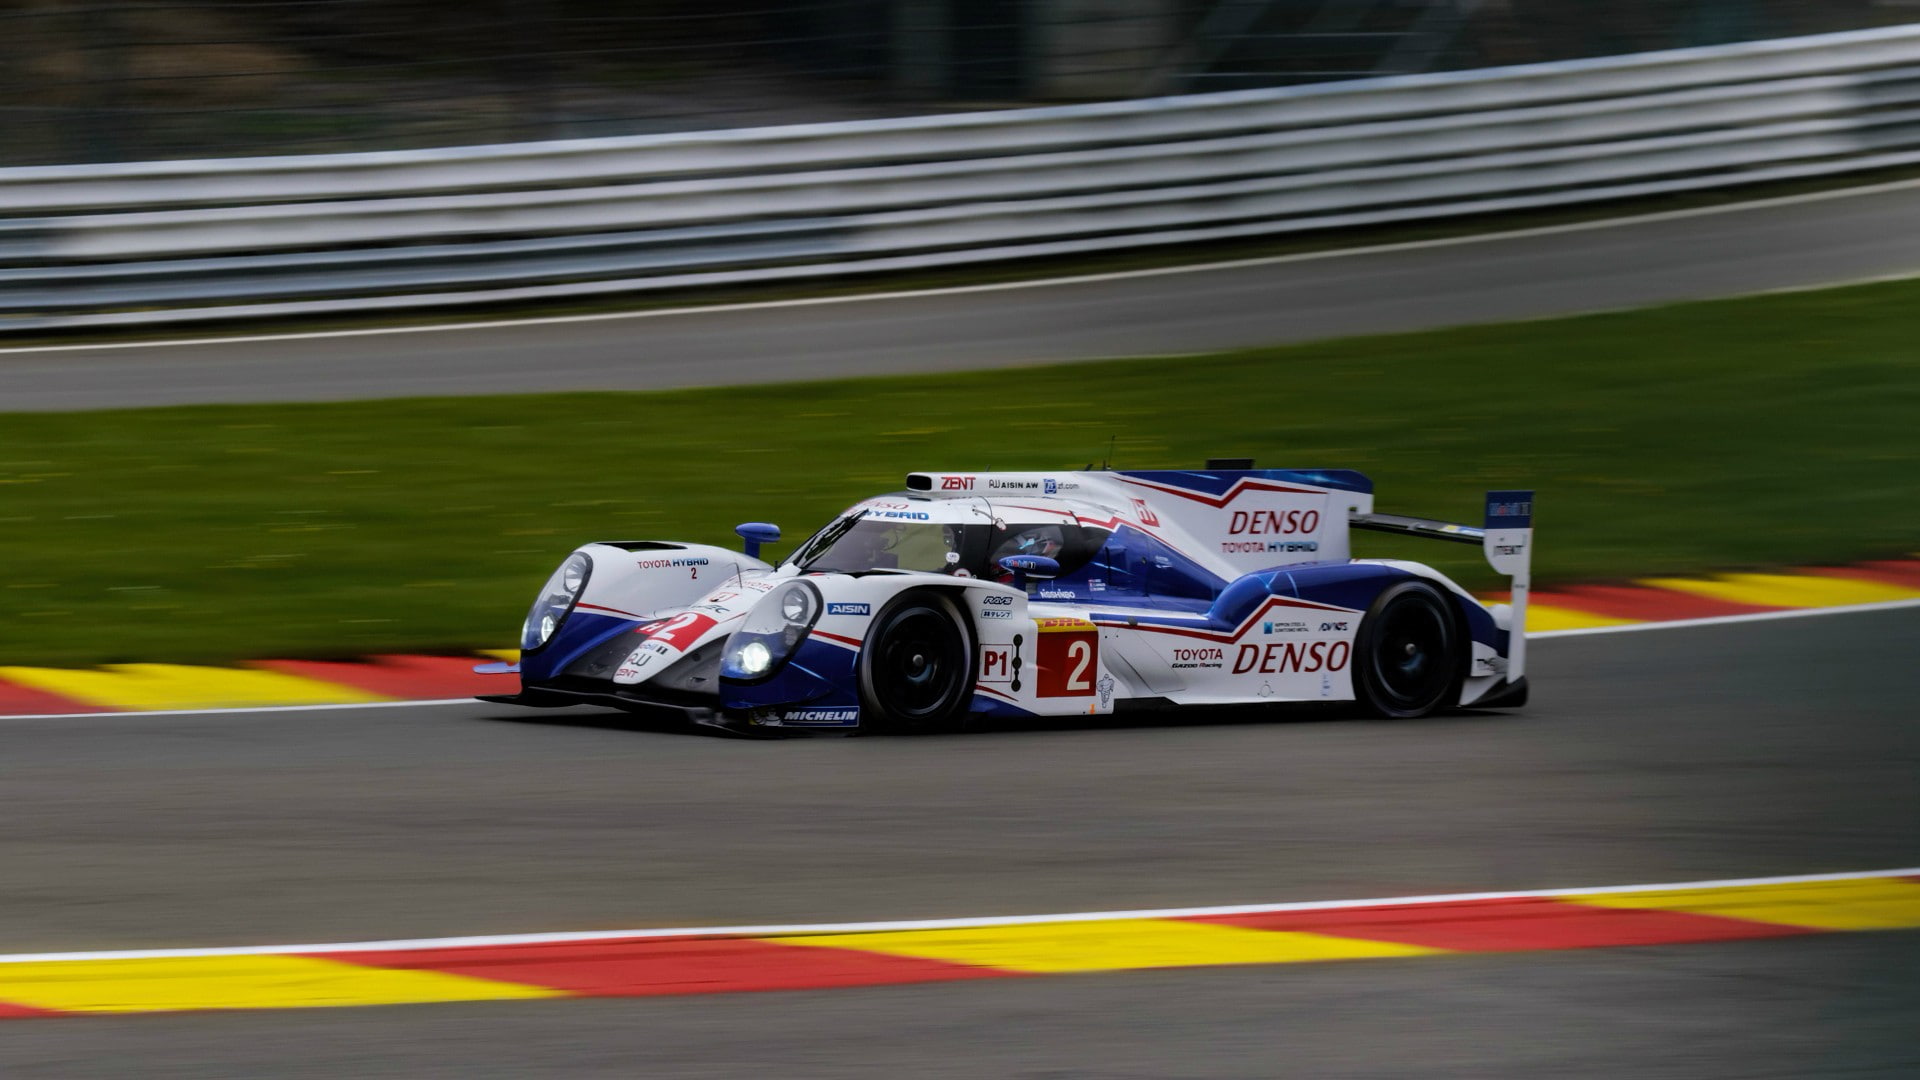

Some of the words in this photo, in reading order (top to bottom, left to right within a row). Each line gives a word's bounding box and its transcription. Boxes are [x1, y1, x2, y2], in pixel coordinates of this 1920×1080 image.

[941, 477, 976, 490] ZENT
[1228, 509, 1320, 535] DENSO
[1221, 542, 1266, 554] TOYOTA
[1267, 541, 1320, 553] HYBRID
[637, 559, 672, 570] TOYOTA
[672, 557, 709, 568] HYBRID
[690, 567, 698, 580] 2
[983, 595, 1013, 606] RAYS
[831, 604, 869, 614] AISIN
[651, 611, 699, 641] 2
[1043, 618, 1087, 628] DHL
[1173, 648, 1224, 661] TOYOTA
[1231, 640, 1350, 675] DENSO
[983, 651, 1008, 677] P1
[1066, 640, 1092, 691] 2
[784, 711, 858, 721] MICHELIN
